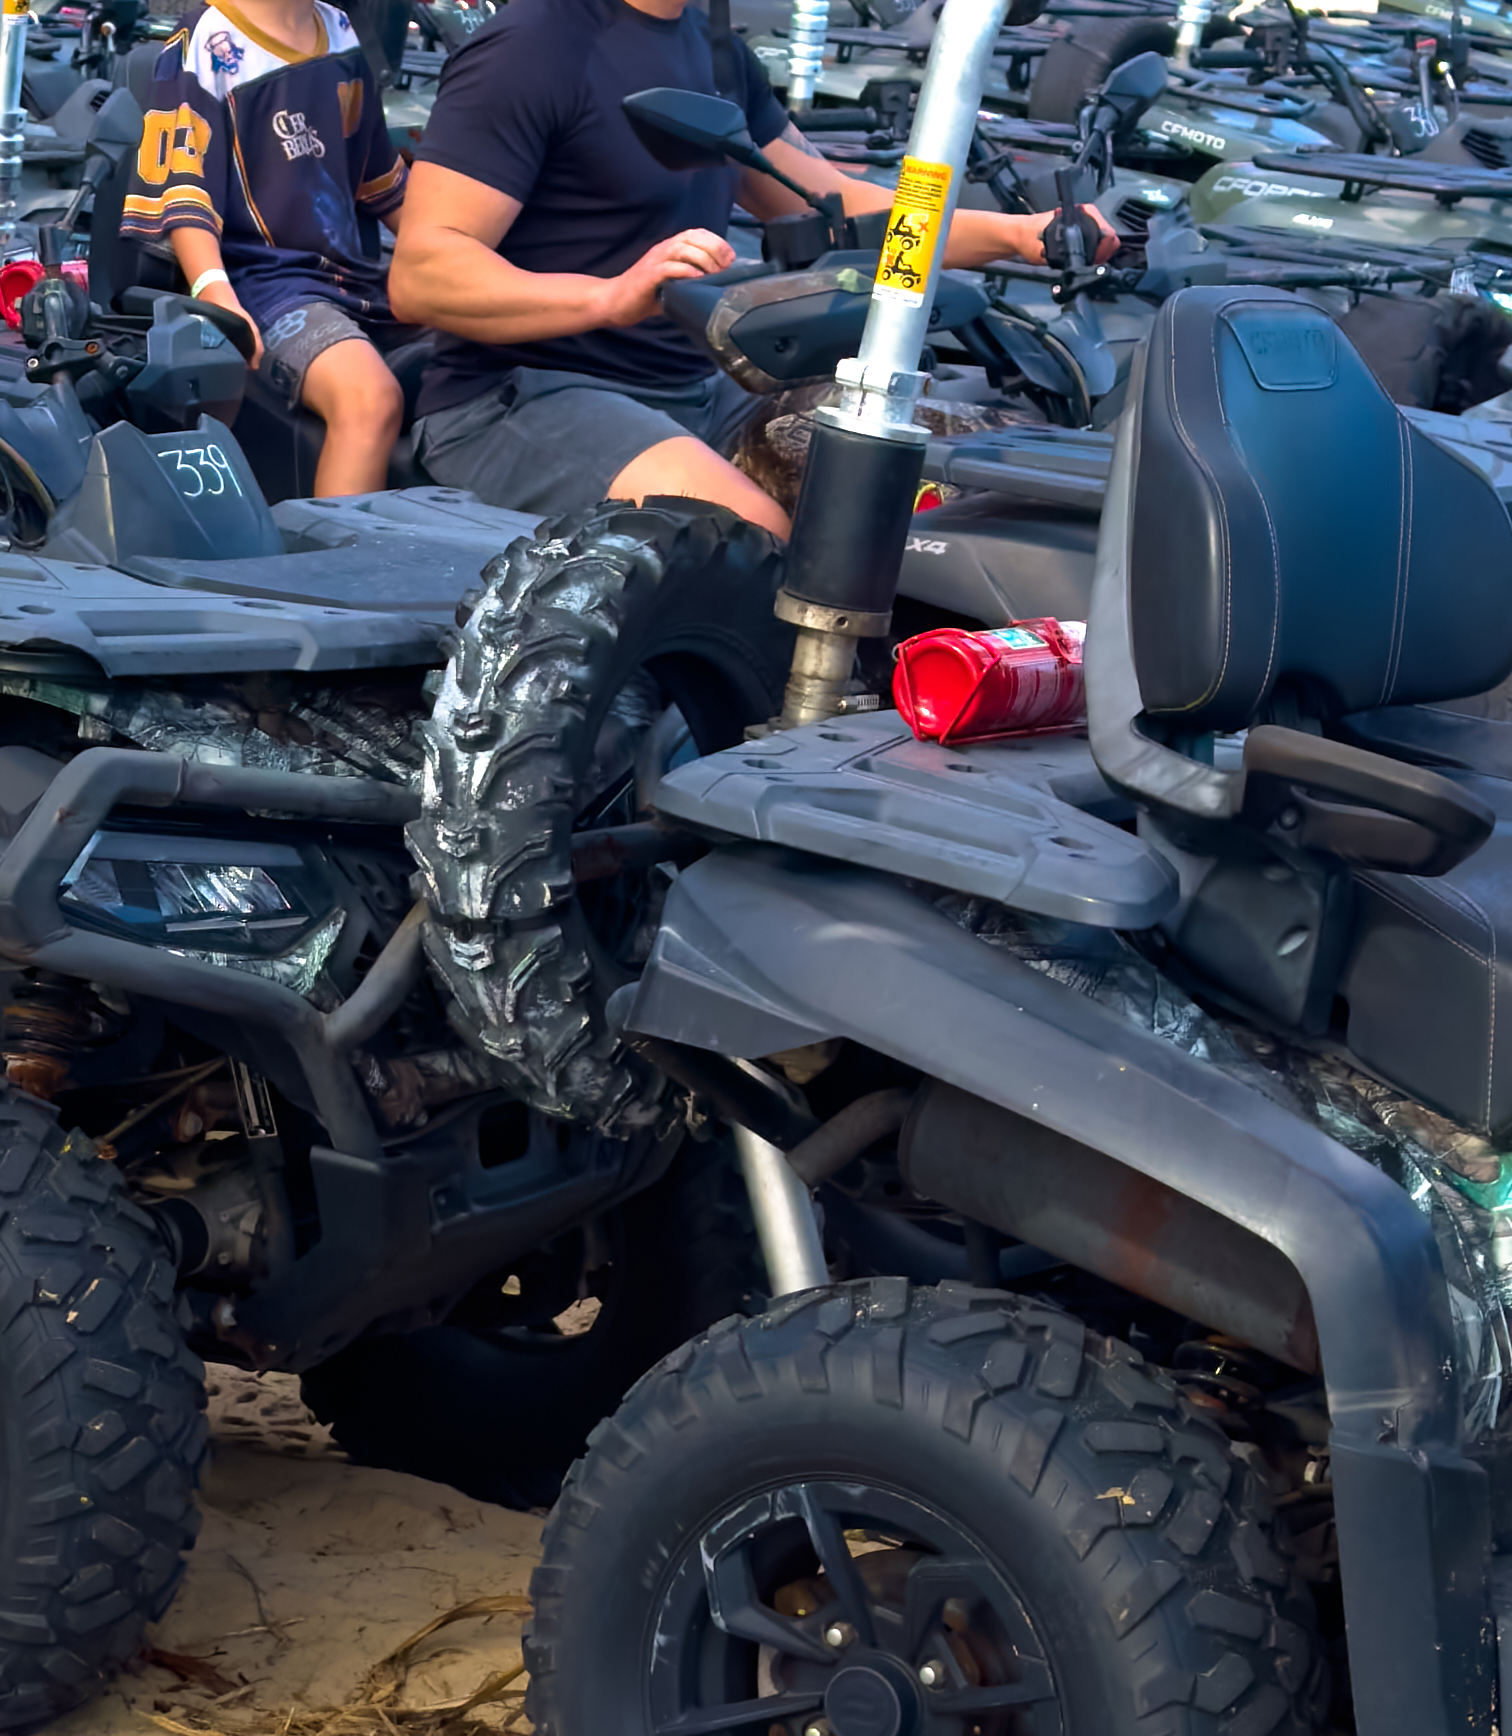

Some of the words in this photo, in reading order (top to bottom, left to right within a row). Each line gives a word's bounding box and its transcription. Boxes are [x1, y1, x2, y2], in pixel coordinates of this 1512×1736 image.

[1160, 120, 1226, 151] CFMOTO
[157, 444, 243, 497] 339
[904, 537, 948, 555] X4
